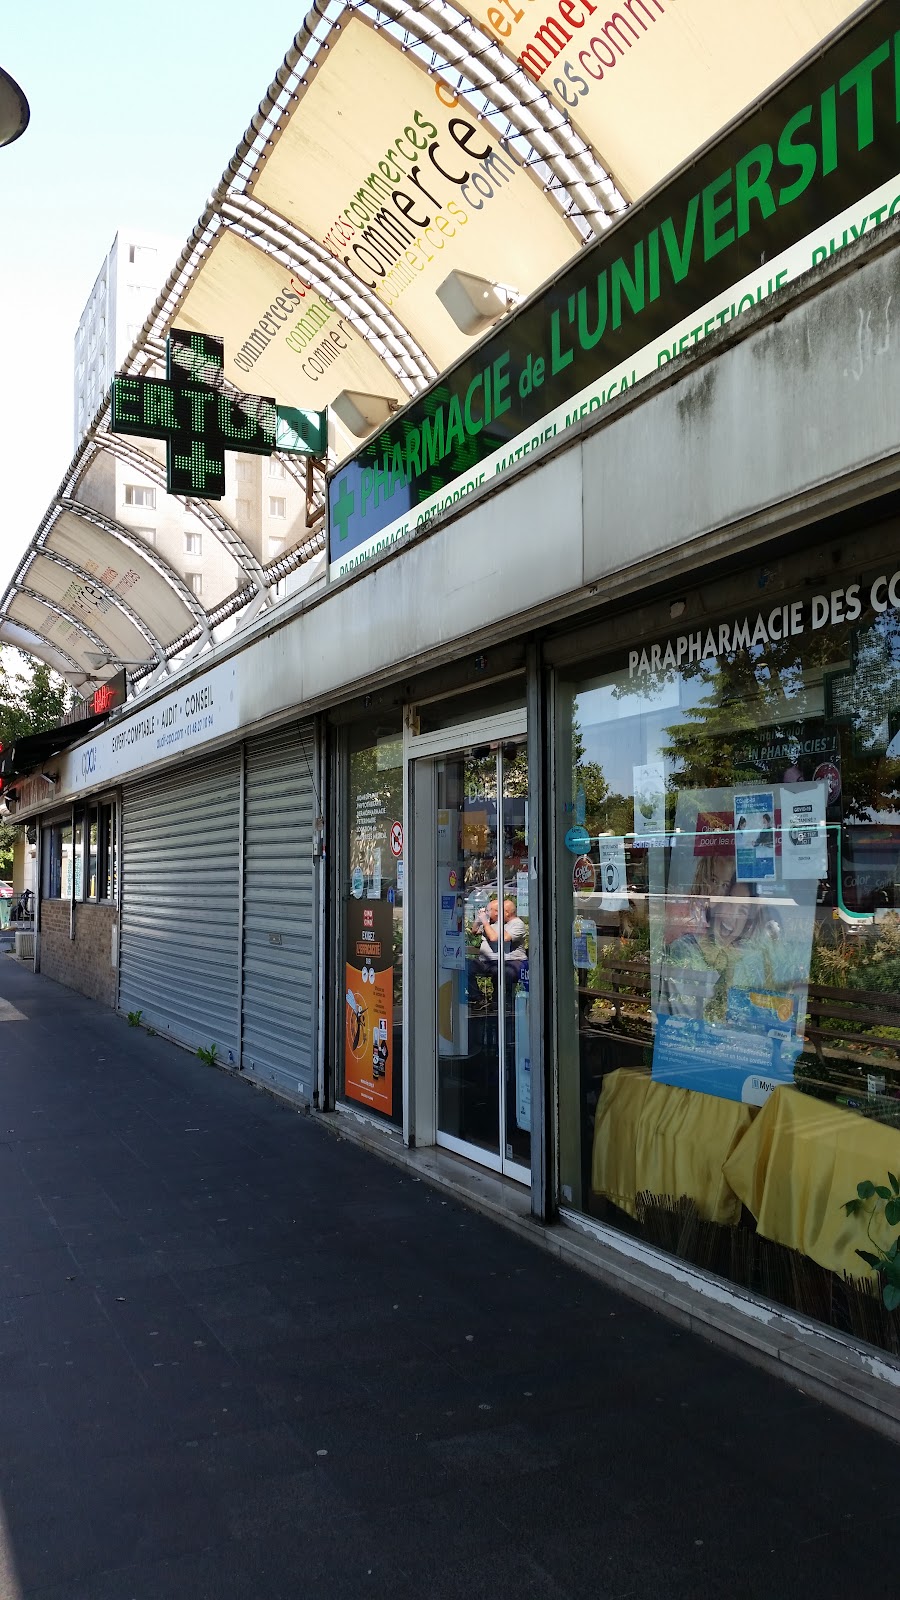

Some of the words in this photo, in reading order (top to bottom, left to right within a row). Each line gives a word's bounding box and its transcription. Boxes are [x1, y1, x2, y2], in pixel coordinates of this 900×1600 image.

[343, 117, 493, 289] commerce
[344, 109, 439, 230] commerces
[375, 200, 469, 306] commerces
[233, 287, 301, 373] commerces
[302, 319, 353, 381] commer
[361, 350, 512, 518] PHARMACIE
[518, 353, 546, 398] de
[628, 601, 805, 679] PARAPHARMACIE
[812, 584, 862, 631] DES
[112, 716, 155, 753] EXPERT-COMPTABLE
[161, 703, 178, 729] AUDIT
[184, 684, 214, 718] CONSEIL
